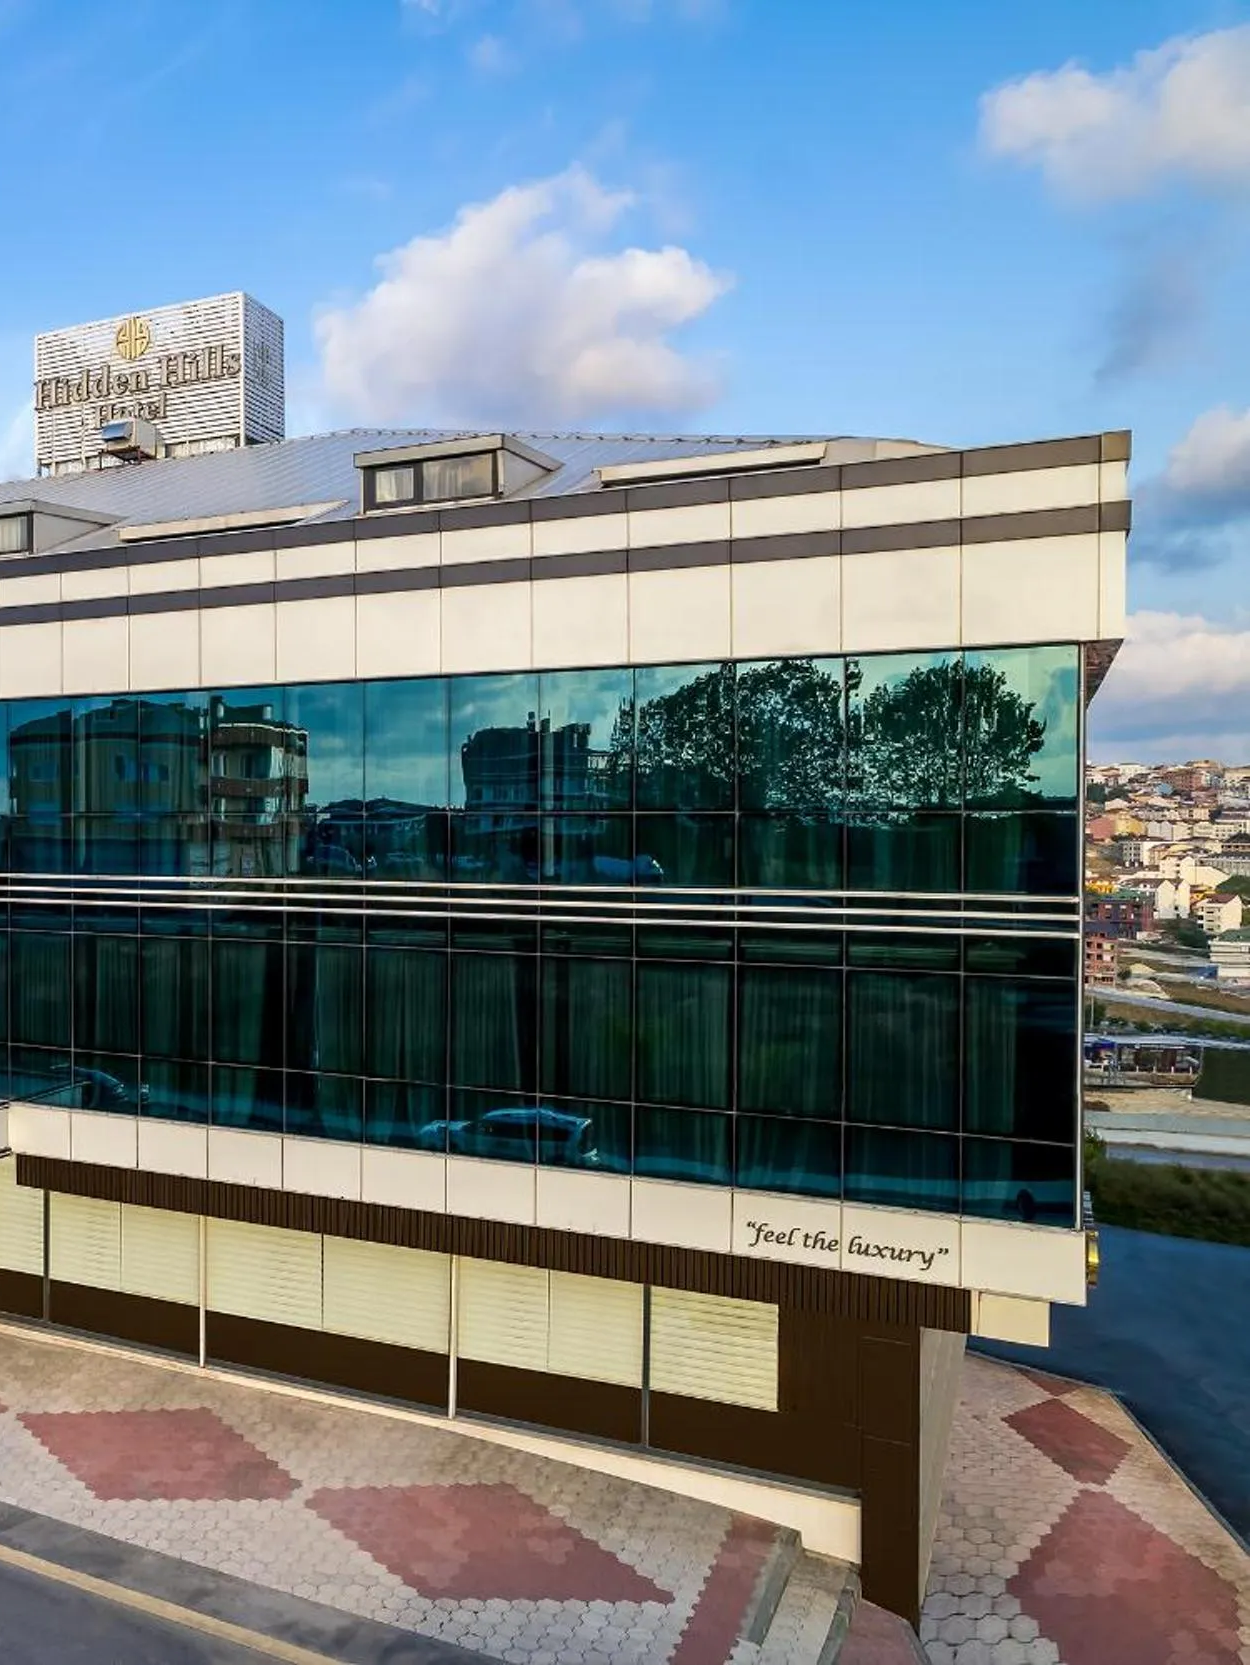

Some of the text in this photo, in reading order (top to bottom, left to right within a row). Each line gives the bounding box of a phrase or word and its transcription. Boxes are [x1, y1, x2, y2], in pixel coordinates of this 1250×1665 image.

[34, 344, 242, 411] Hidden Hills
[803, 1230, 840, 1252] the
